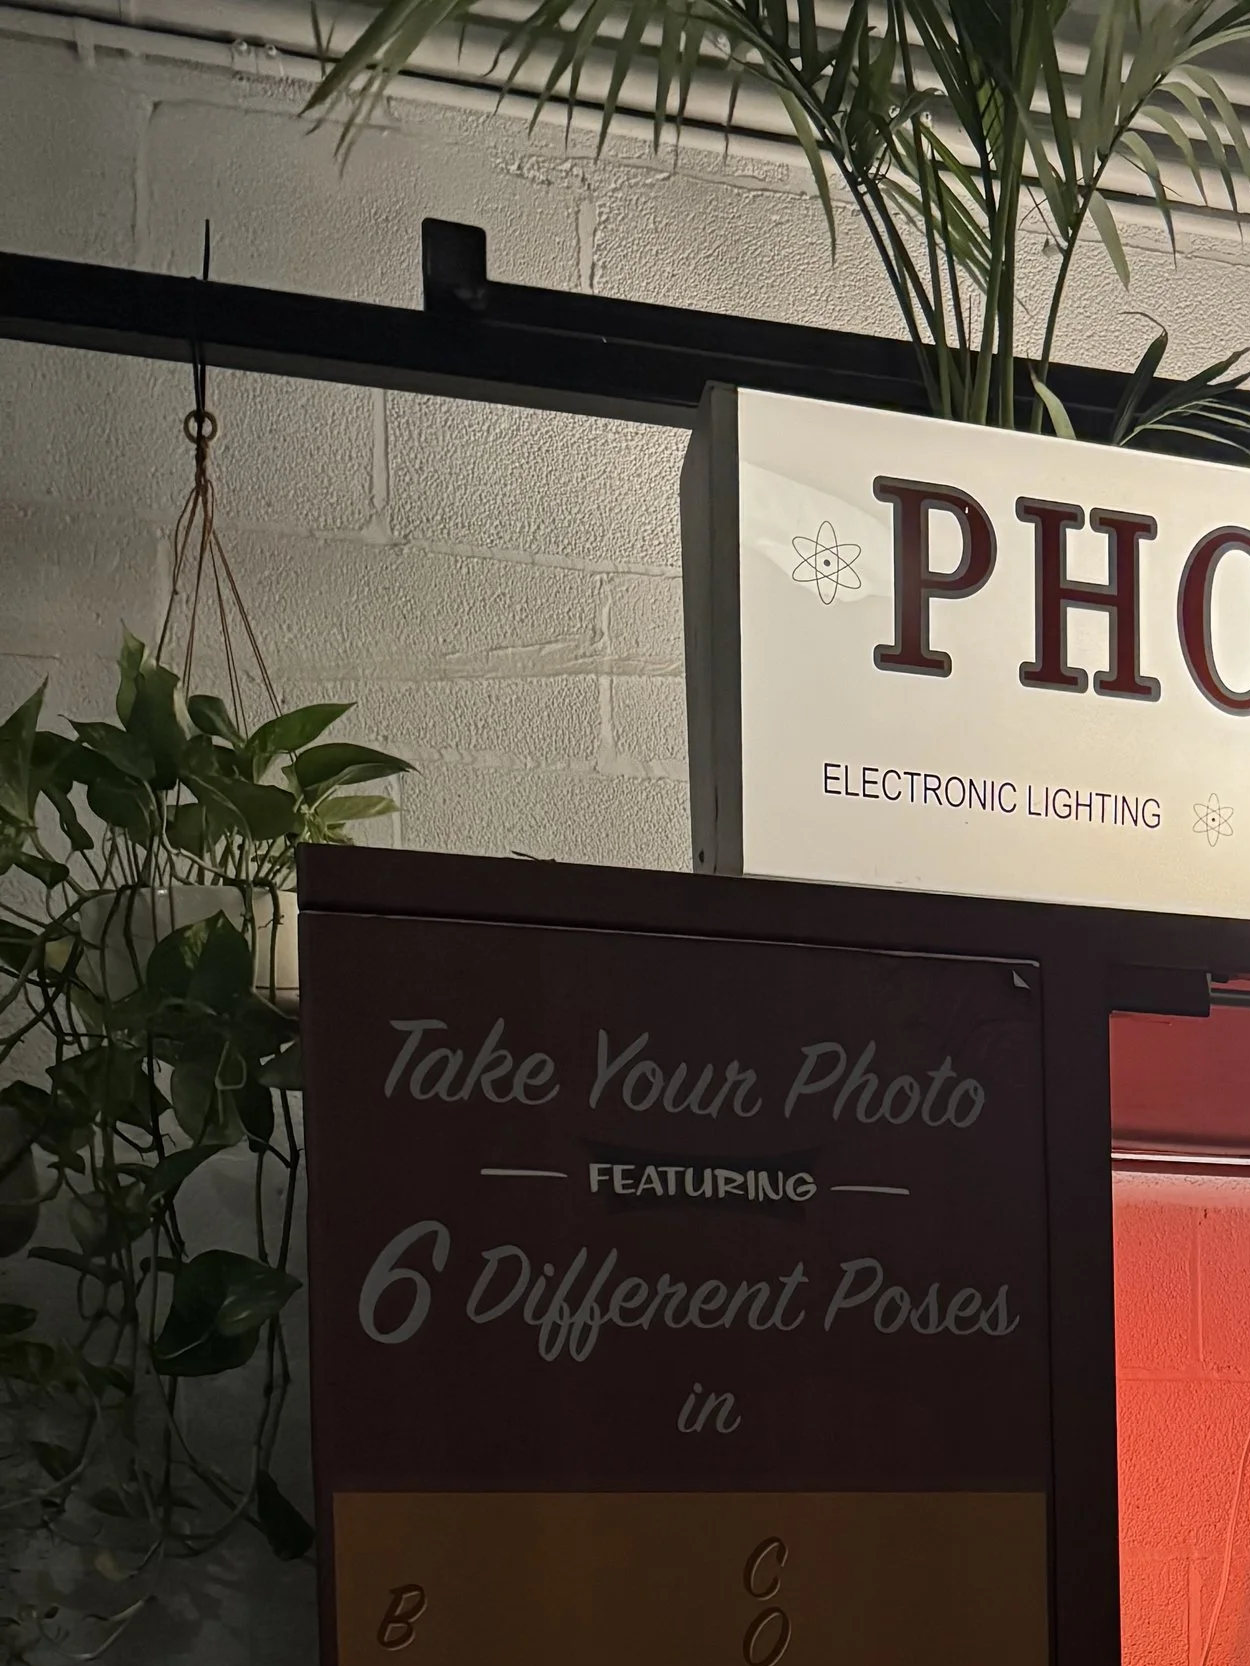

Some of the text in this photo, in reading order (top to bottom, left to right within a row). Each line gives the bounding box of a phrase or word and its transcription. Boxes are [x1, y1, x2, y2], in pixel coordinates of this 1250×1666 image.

[823, 762, 1162, 829] ELECTRONIC LIGHTING
[383, 1017, 987, 1129] Take Your Photo
[588, 1162, 818, 1202] FEATURING
[358, 1219, 1021, 1362] 6 Different Poses
[676, 1382, 742, 1434] in
